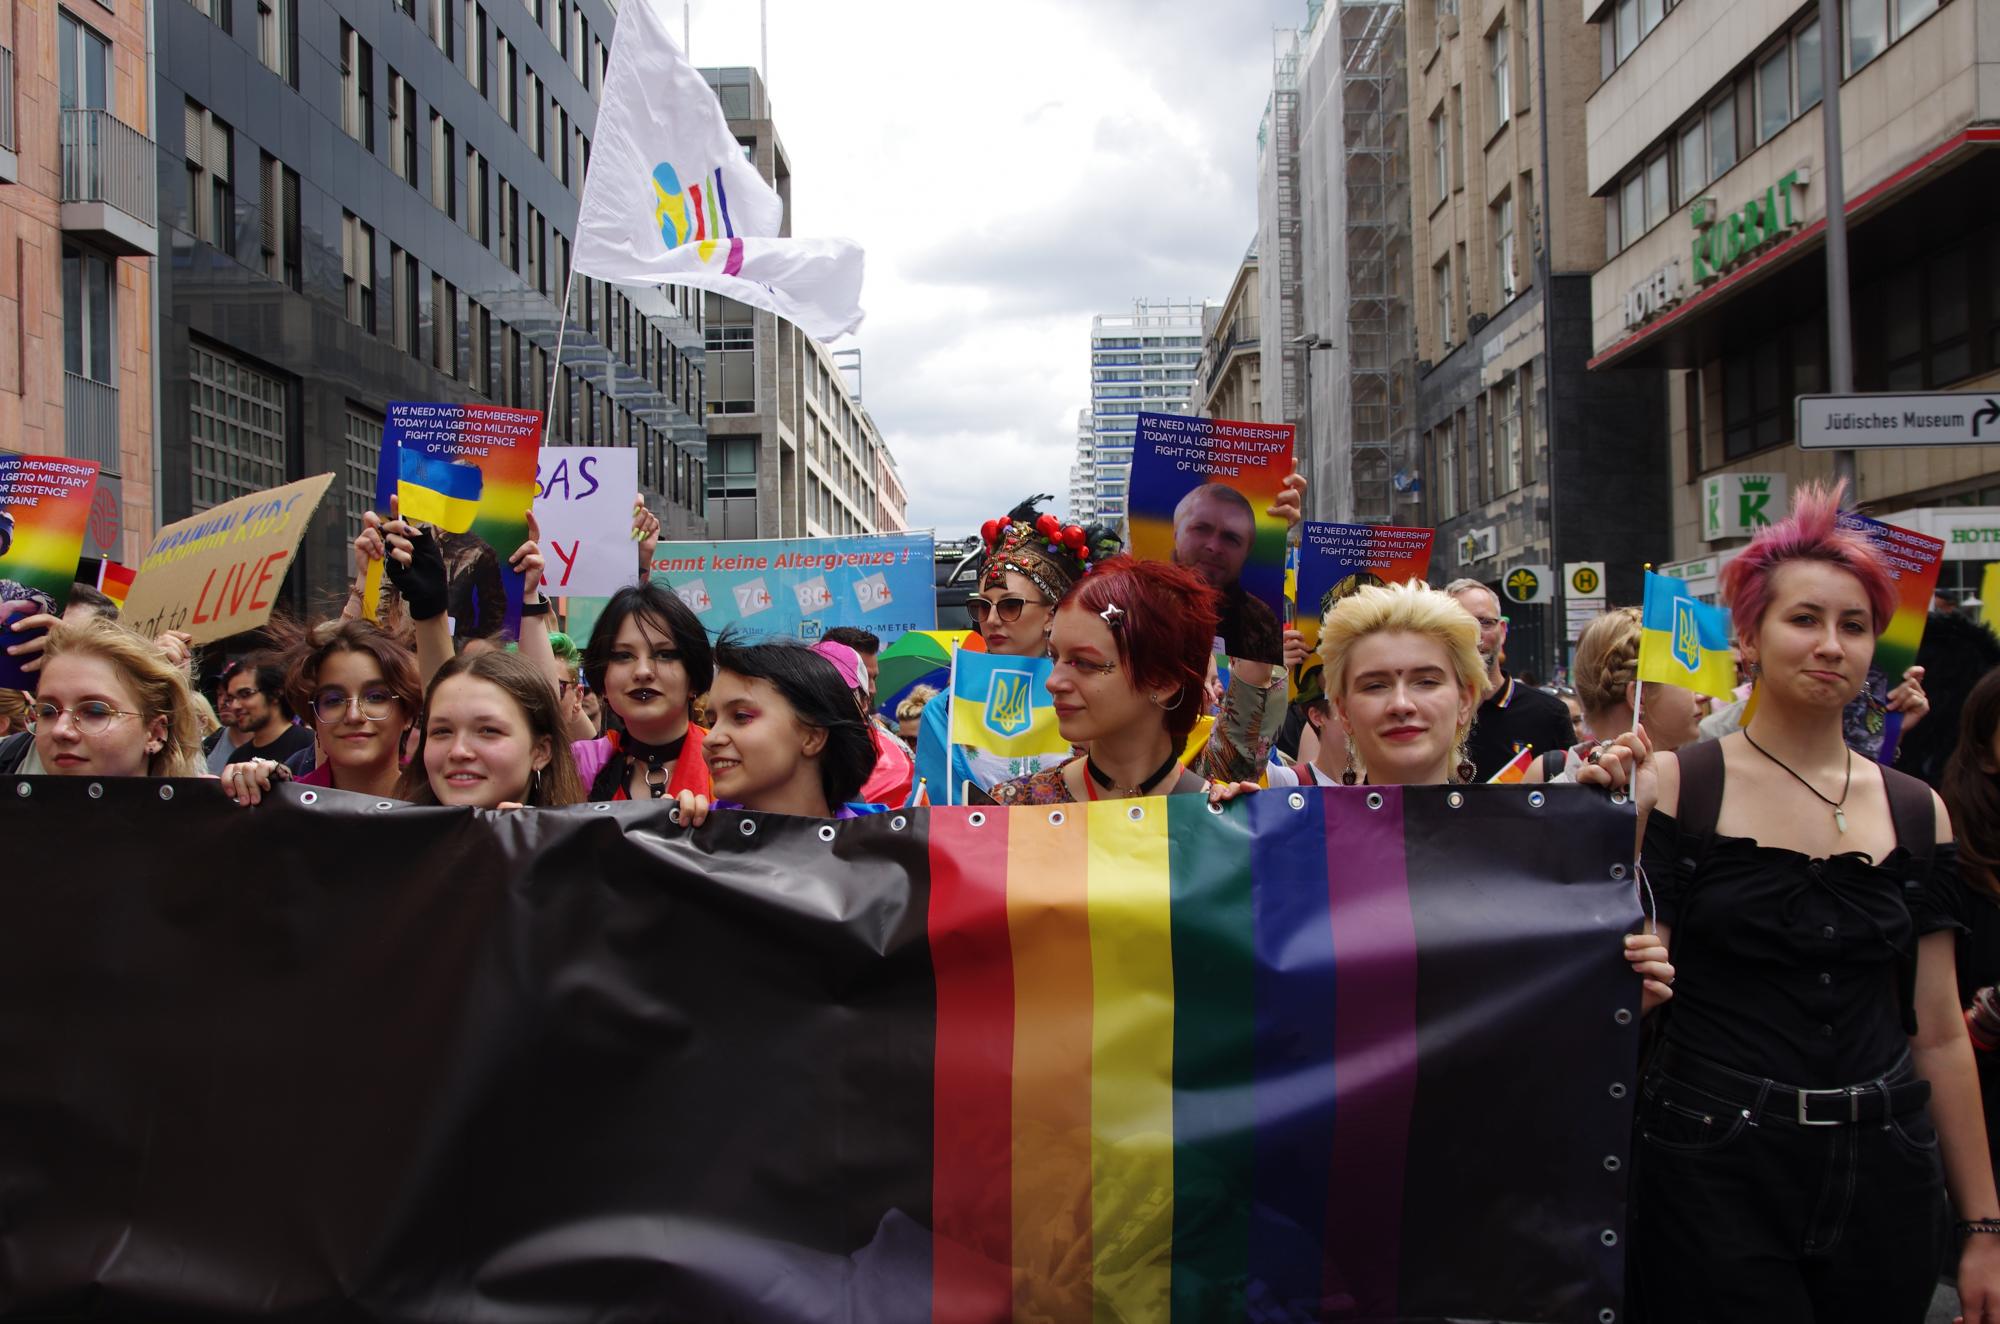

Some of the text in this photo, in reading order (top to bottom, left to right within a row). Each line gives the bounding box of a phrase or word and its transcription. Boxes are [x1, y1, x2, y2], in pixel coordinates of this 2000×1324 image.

[1624, 170, 1799, 328] HOTEL KUBRAT
[392, 406, 538, 425] WE NEED NATO MEMBERSHIP
[1825, 412, 1965, 430] Jüdisches Museum
[393, 418, 534, 436] TODAY! UA LGBTIQ MILITARY
[1142, 418, 1290, 440] WE NEED NATO MEMBERSHIP
[405, 431, 516, 447] FIGHT FOR EXISTENCE
[1142, 431, 1285, 453] TODAY! UA LGBTIQ MILITARY
[427, 444, 489, 456] OF UKRAINE
[1155, 445, 1267, 466] FIGHT FOR EXISTENCE
[23, 462, 95, 477] MEMBERSHIP
[1177, 461, 1239, 477] OF UKRAINE
[1, 473, 89, 488] LGBTIQ MILITARY
[10, 484, 69, 498] EXISTENCE
[0, 496, 39, 507] KRAINE
[1739, 494, 1771, 527] K
[1307, 526, 1431, 540] WE NEED NATO MEMBERSHIP
[1889, 530, 1942, 551] MEMBERSHIP
[1952, 528, 2000, 544] HOTE
[1309, 536, 1427, 550] TODAY! UA LGBTIQ MILITARY
[1320, 547, 1413, 559] FIGHT FOR EXISTENCE
[1874, 539, 1937, 564] GBTIQ MILITARY
[650, 556, 705, 571] kennt
[712, 554, 767, 570] keine
[774, 551, 896, 571] Altergrenze
[1340, 558, 1391, 568] OF UKRAINE
[1887, 557, 1923, 573] ISTENCE
[192, 550, 289, 624] LIVE
